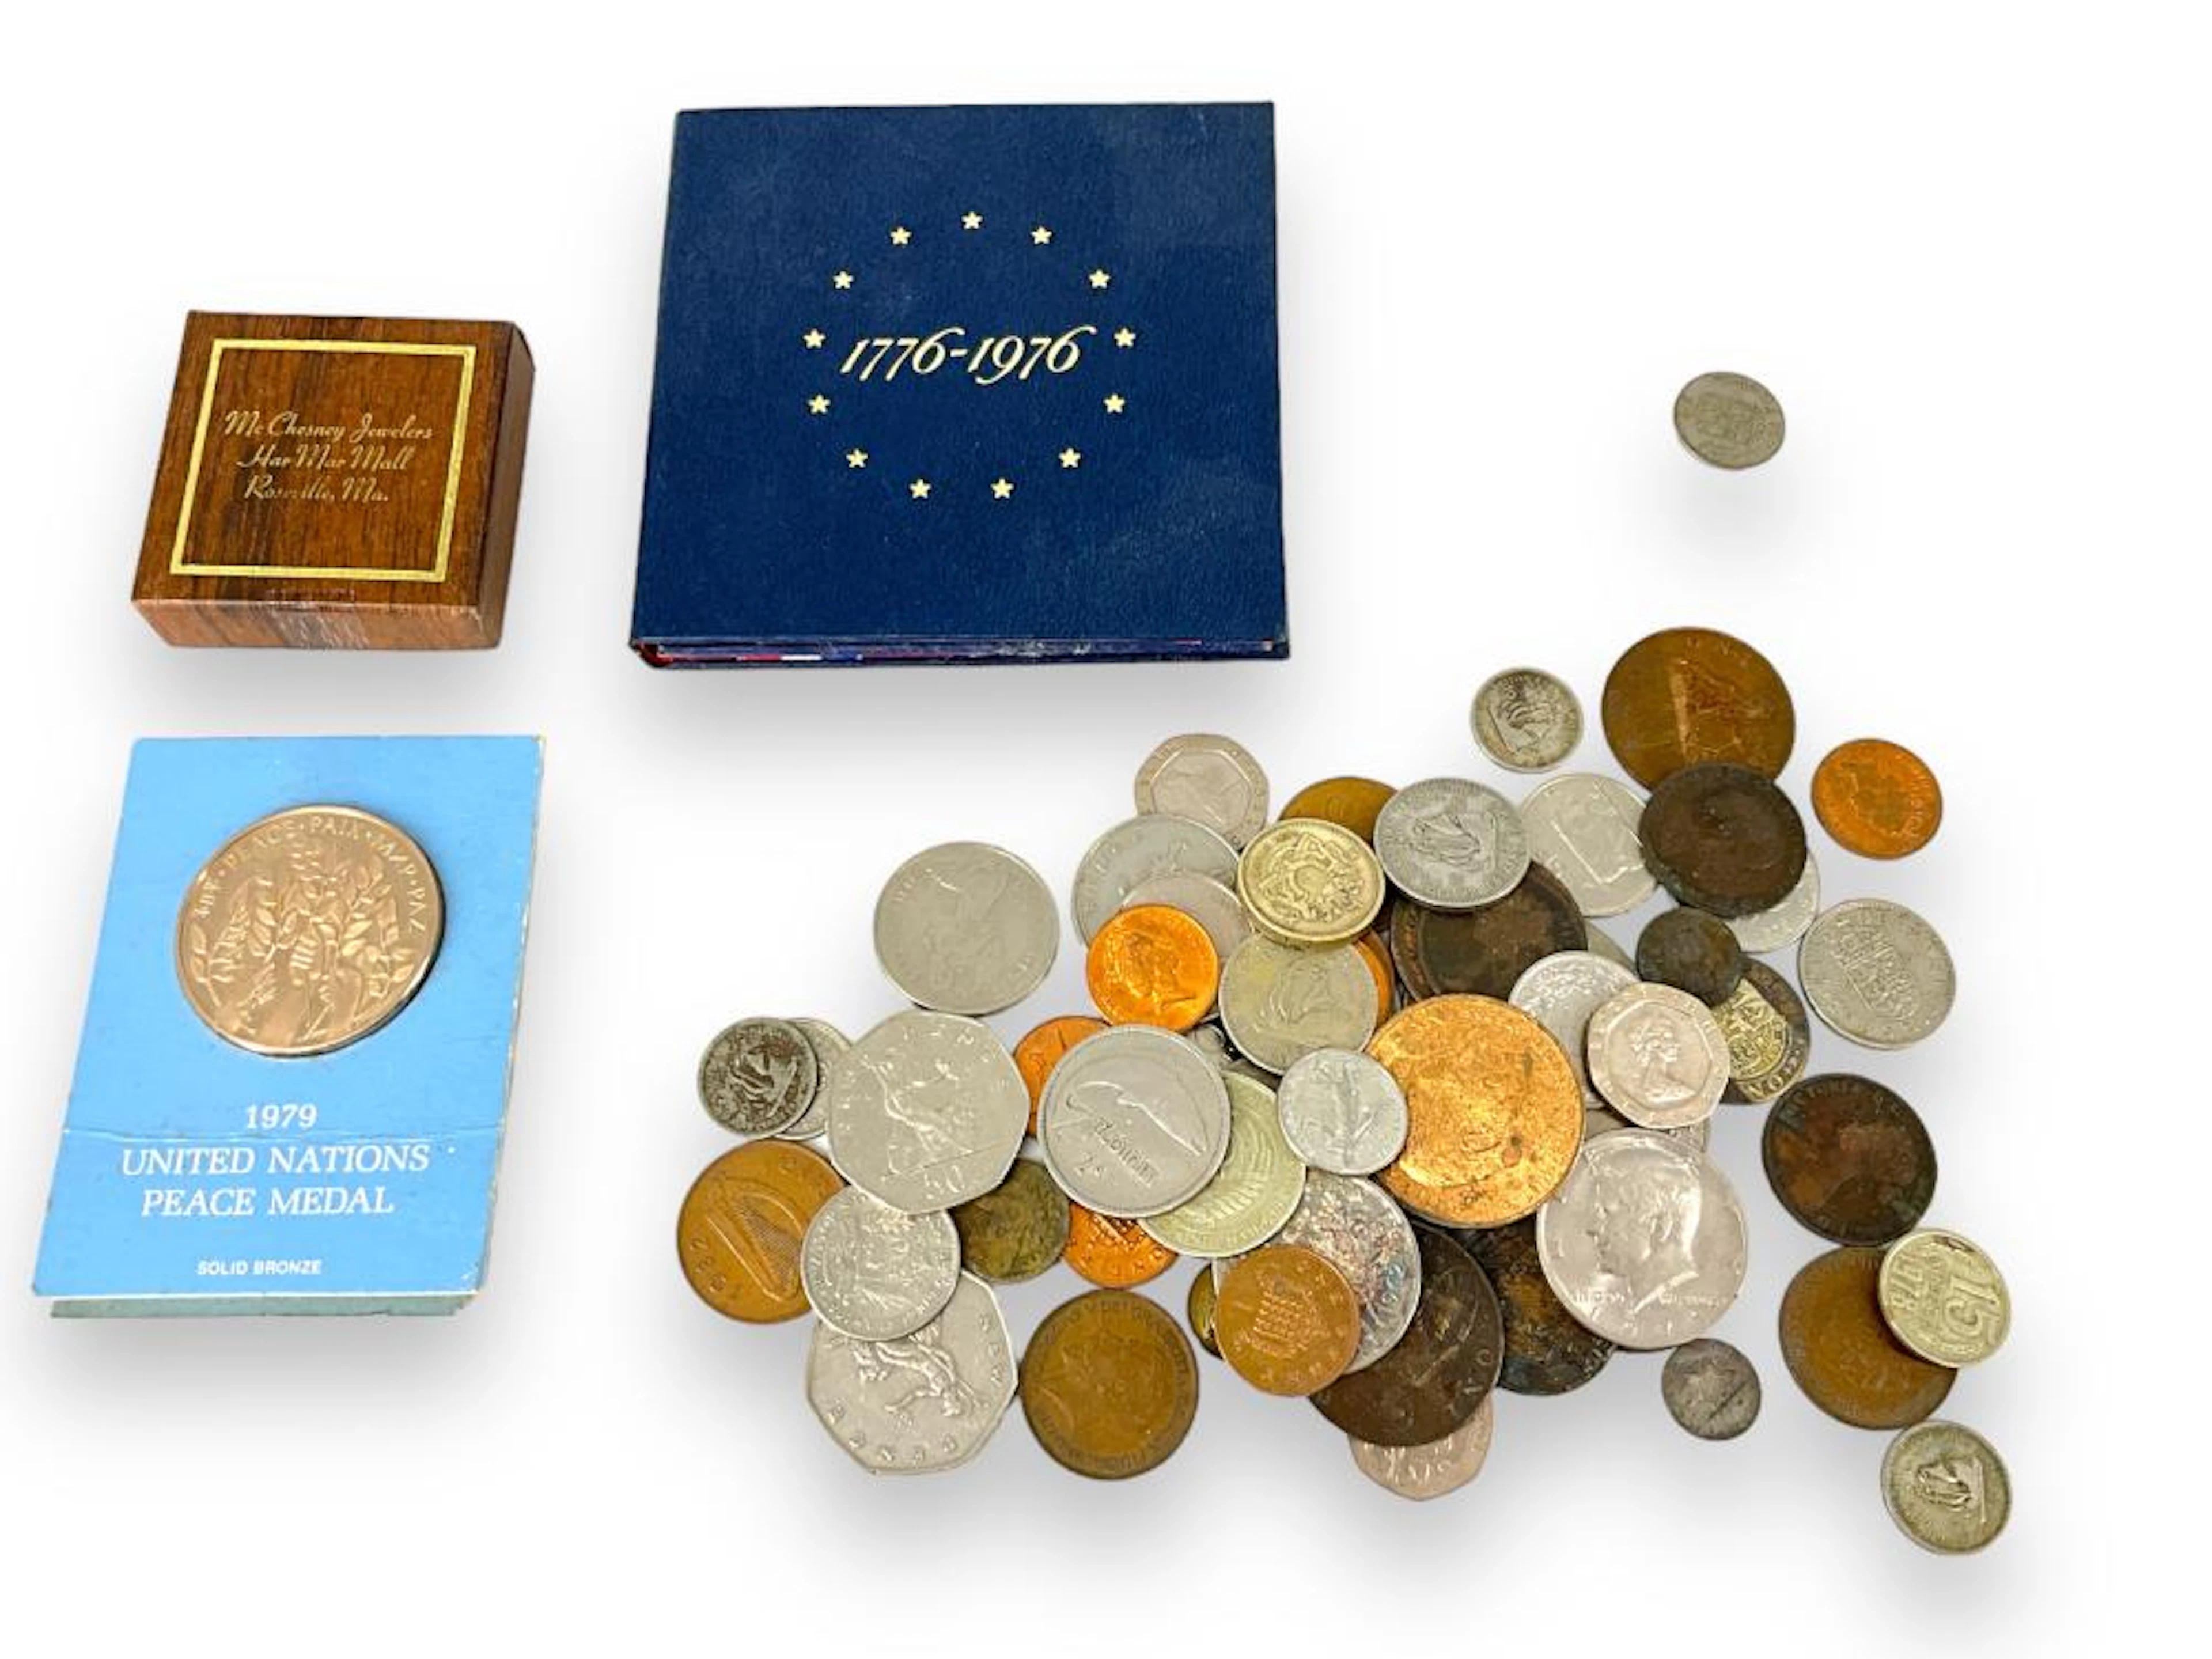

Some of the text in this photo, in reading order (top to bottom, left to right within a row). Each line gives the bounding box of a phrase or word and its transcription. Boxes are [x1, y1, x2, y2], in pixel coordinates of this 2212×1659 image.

[840, 325, 1097, 385] 1776-1976
[268, 410, 346, 442] Chesney
[349, 412, 433, 443] Jewelers
[236, 443, 416, 472] Har Mar Mall
[246, 1104, 318, 1130] 1979
[122, 1143, 431, 1176] UNITED NATIONS
[141, 1185, 396, 1217] PEACE MEDAL
[195, 1258, 324, 1275] SOLID BRONZE
[1941, 1271, 2001, 1347] 15
